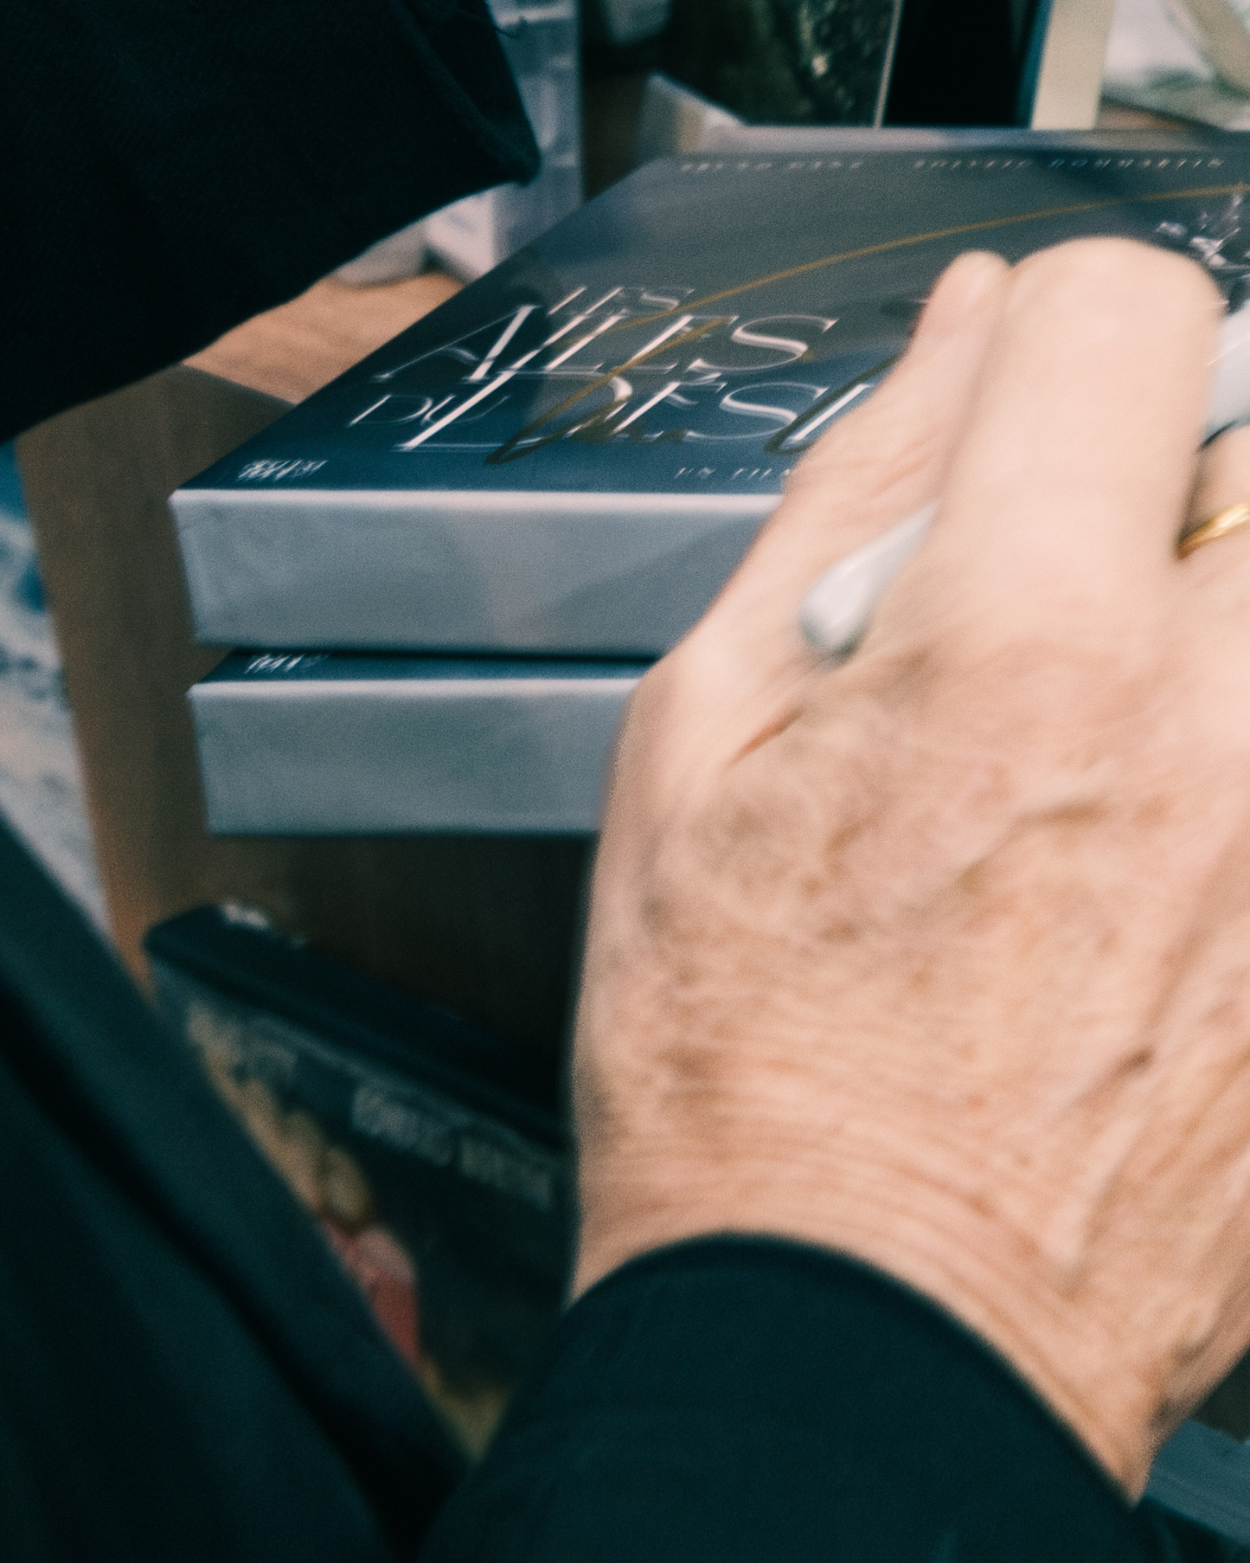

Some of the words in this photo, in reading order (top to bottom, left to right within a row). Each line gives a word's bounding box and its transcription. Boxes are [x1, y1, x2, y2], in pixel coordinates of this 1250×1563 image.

[370, 303, 840, 382] AILES
[393, 370, 878, 452] DÉSI
[731, 466, 790, 480] FIL
